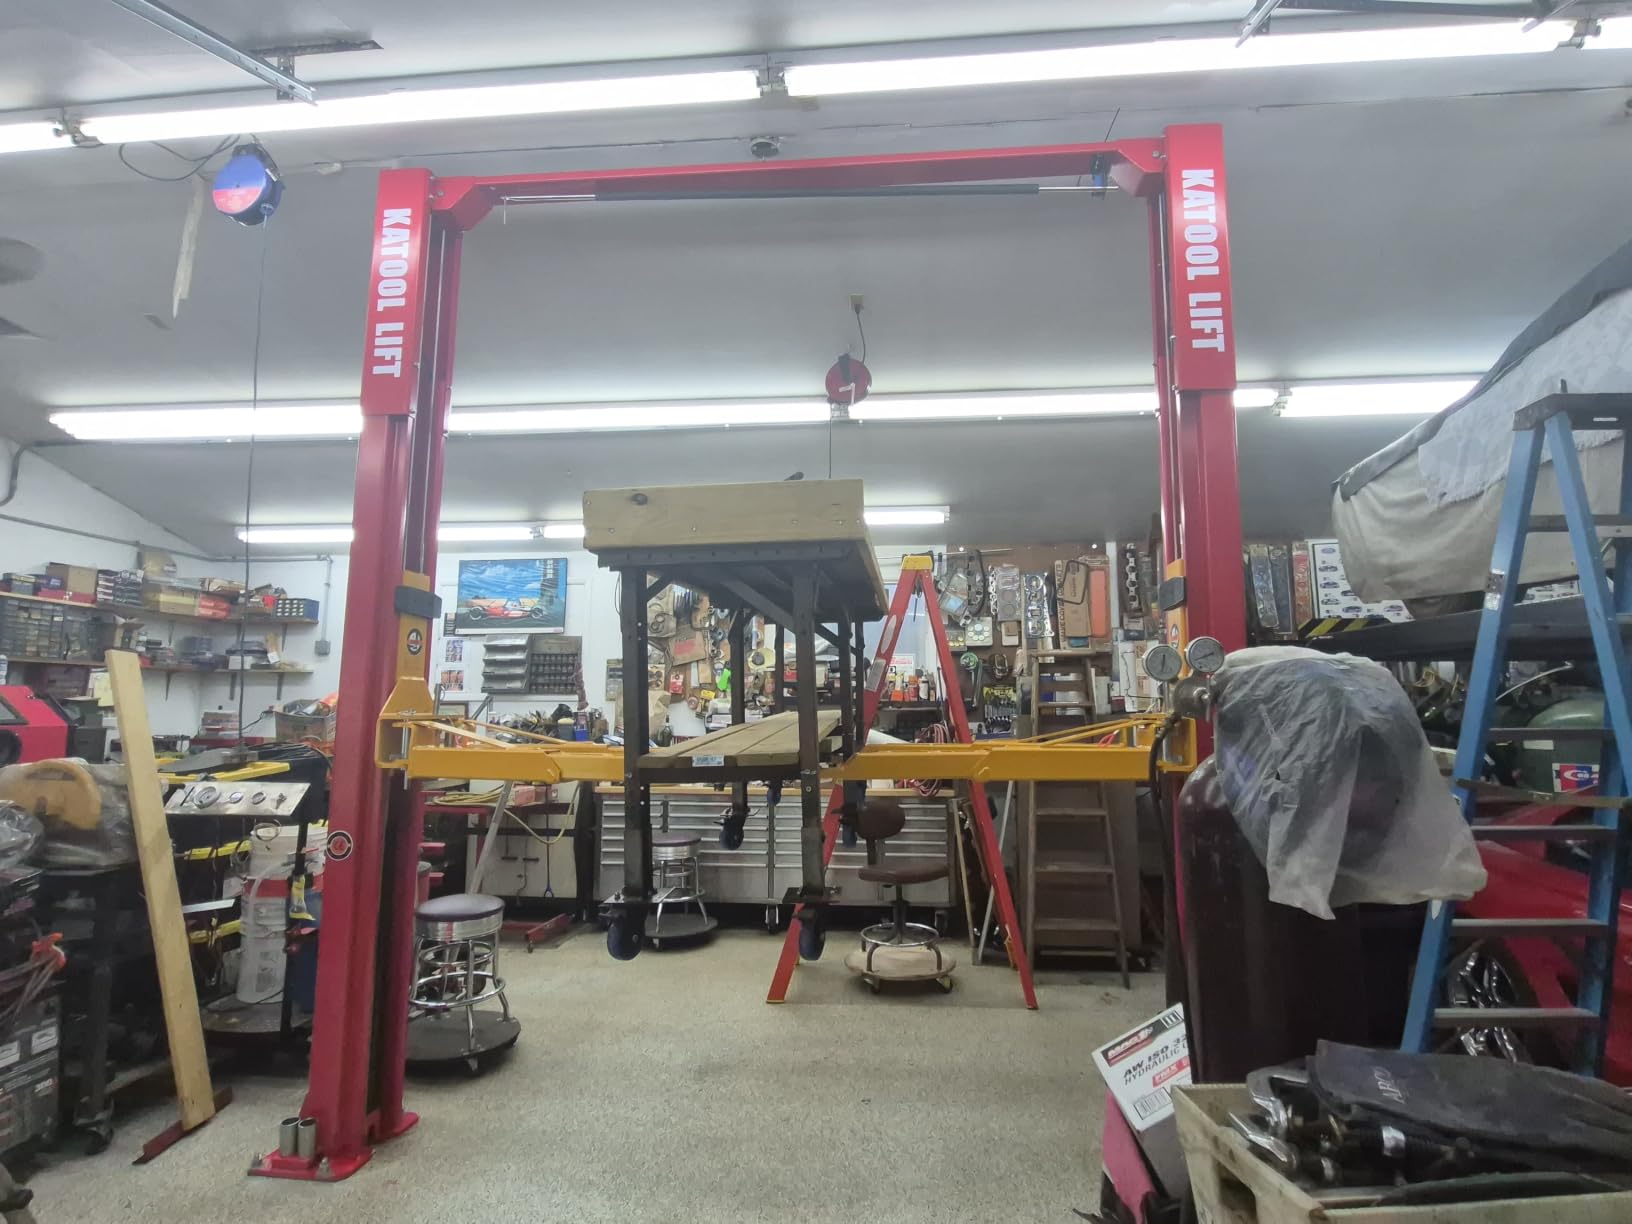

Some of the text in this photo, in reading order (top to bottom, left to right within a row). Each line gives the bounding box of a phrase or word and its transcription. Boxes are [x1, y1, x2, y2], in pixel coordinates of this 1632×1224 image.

[372, 208, 412, 378] KATOOL LIFT
[1181, 169, 1225, 353] KATOOL LIFT
[1123, 1060, 1144, 1078] AW
[1147, 1045, 1169, 1063] ISO
[1124, 1047, 1181, 1086] HYDRAULIC
